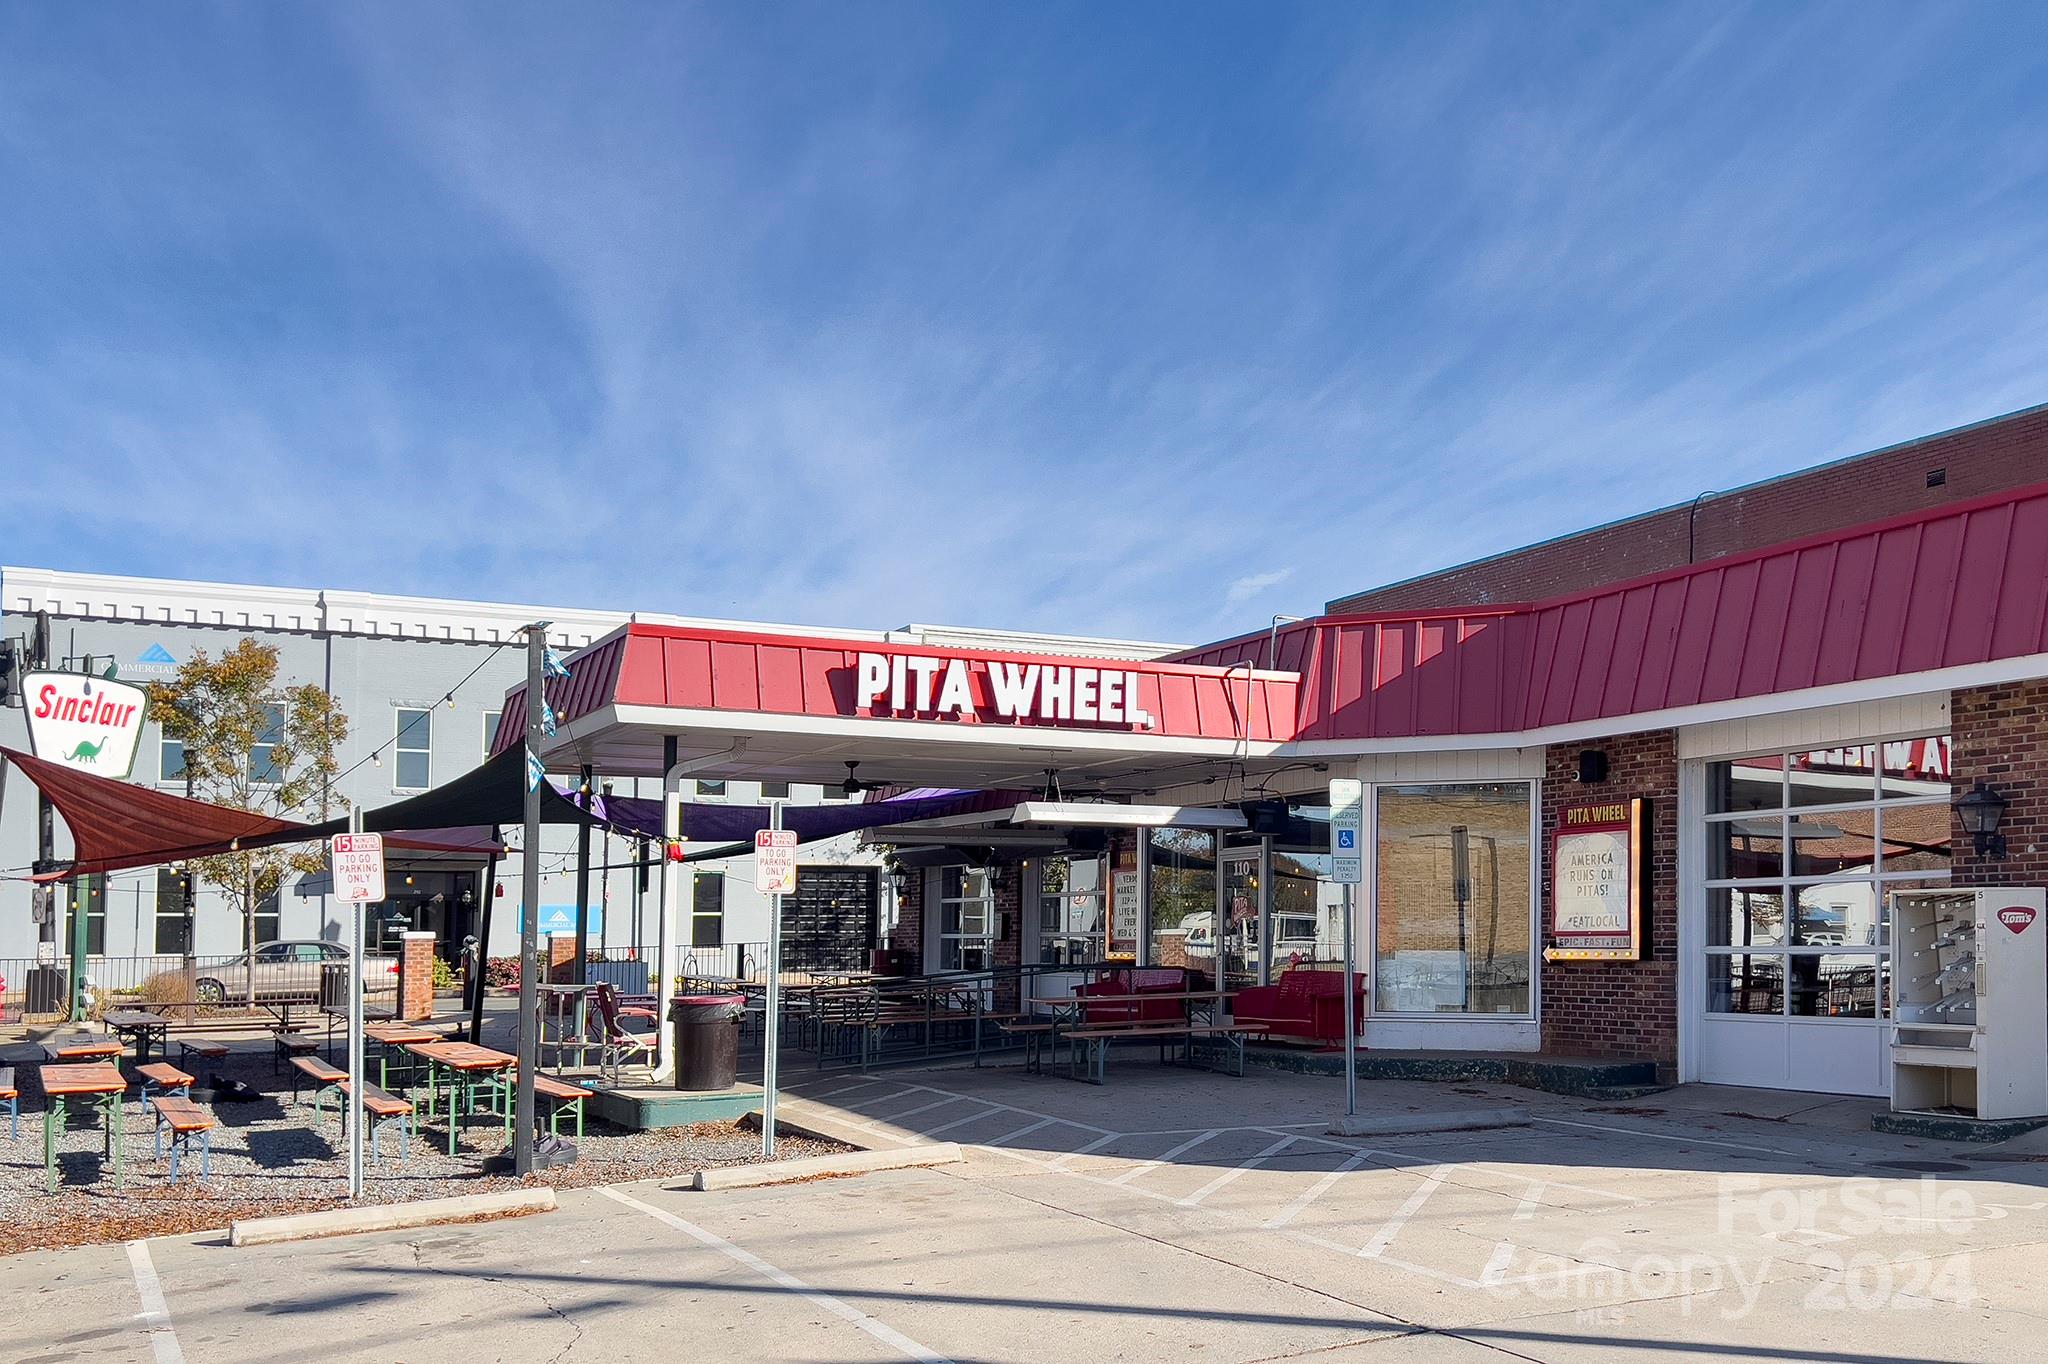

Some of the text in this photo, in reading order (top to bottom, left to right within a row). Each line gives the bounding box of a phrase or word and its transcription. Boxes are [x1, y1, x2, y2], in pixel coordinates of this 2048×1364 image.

[101, 663, 174, 674] CMMERCIAL
[857, 653, 1148, 723] PITA WHEEL
[35, 683, 137, 728] Sinclair
[1568, 805, 1626, 824] PITA WHEEL
[1334, 820, 1358, 828] PARKING
[335, 836, 352, 852] 15
[759, 832, 771, 846] 15
[345, 854, 371, 864] TO GO
[765, 848, 786, 858] TO GO
[760, 858, 792, 867] PARKING
[1571, 853, 1614, 867] AMERICA
[339, 863, 378, 874] PARKING
[765, 867, 786, 876] ONLY
[1233, 861, 1250, 877] 110
[1570, 868, 1613, 882] RUNS ON
[347, 874, 371, 884] ONLY
[1576, 884, 1609, 898] PITAS!
[2001, 911, 2032, 924] Tom's
